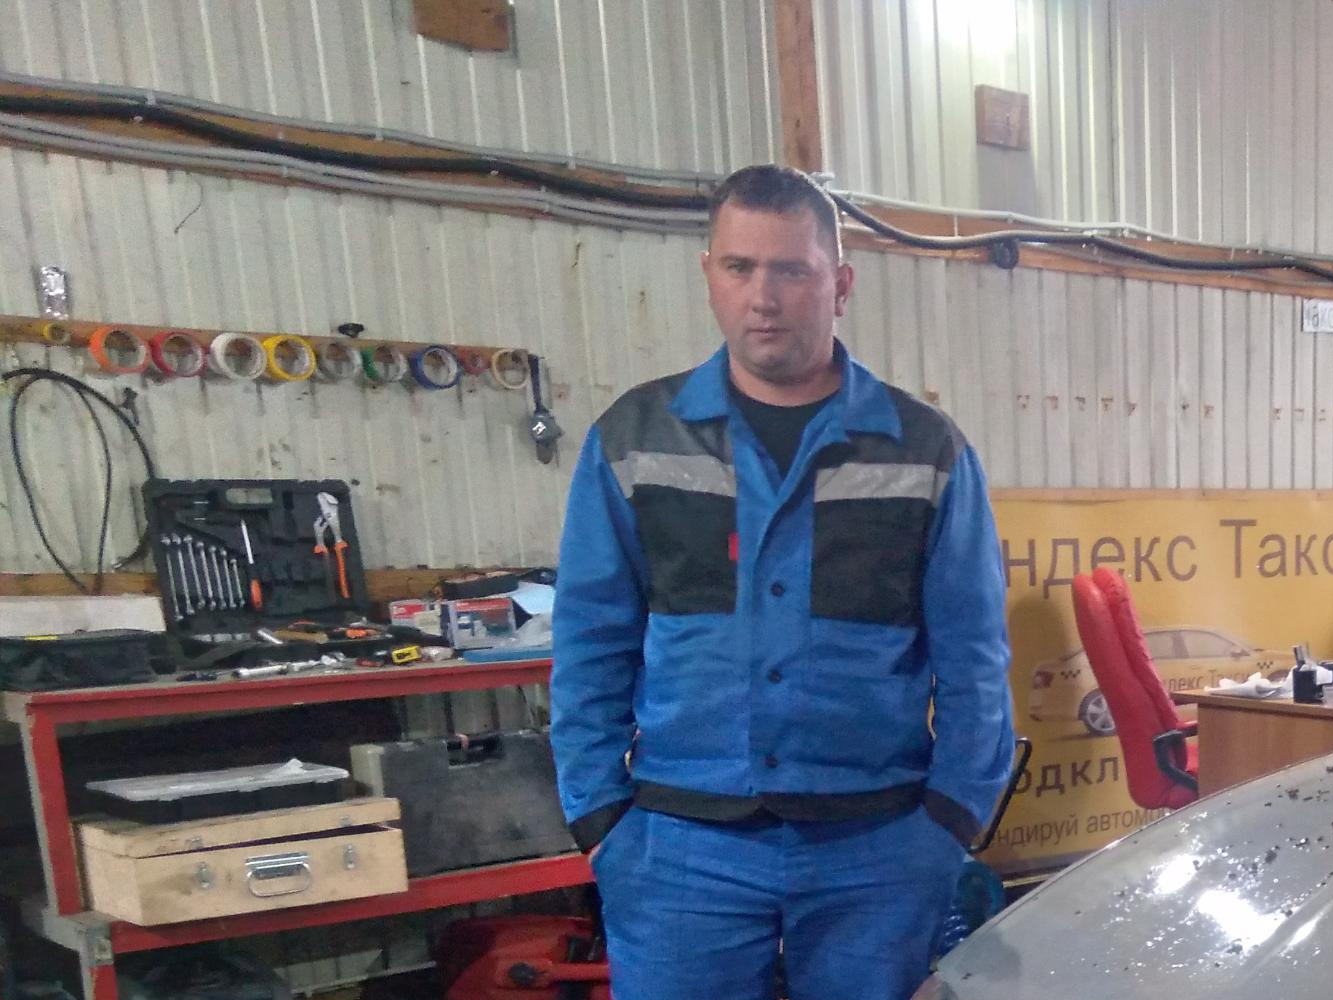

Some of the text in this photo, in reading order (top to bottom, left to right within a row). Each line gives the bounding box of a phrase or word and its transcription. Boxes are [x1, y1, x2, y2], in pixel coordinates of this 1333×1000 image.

[1002, 535, 1197, 600] ндекс
[1013, 757, 1119, 798] одкл
[997, 815, 1078, 847] ндируй
